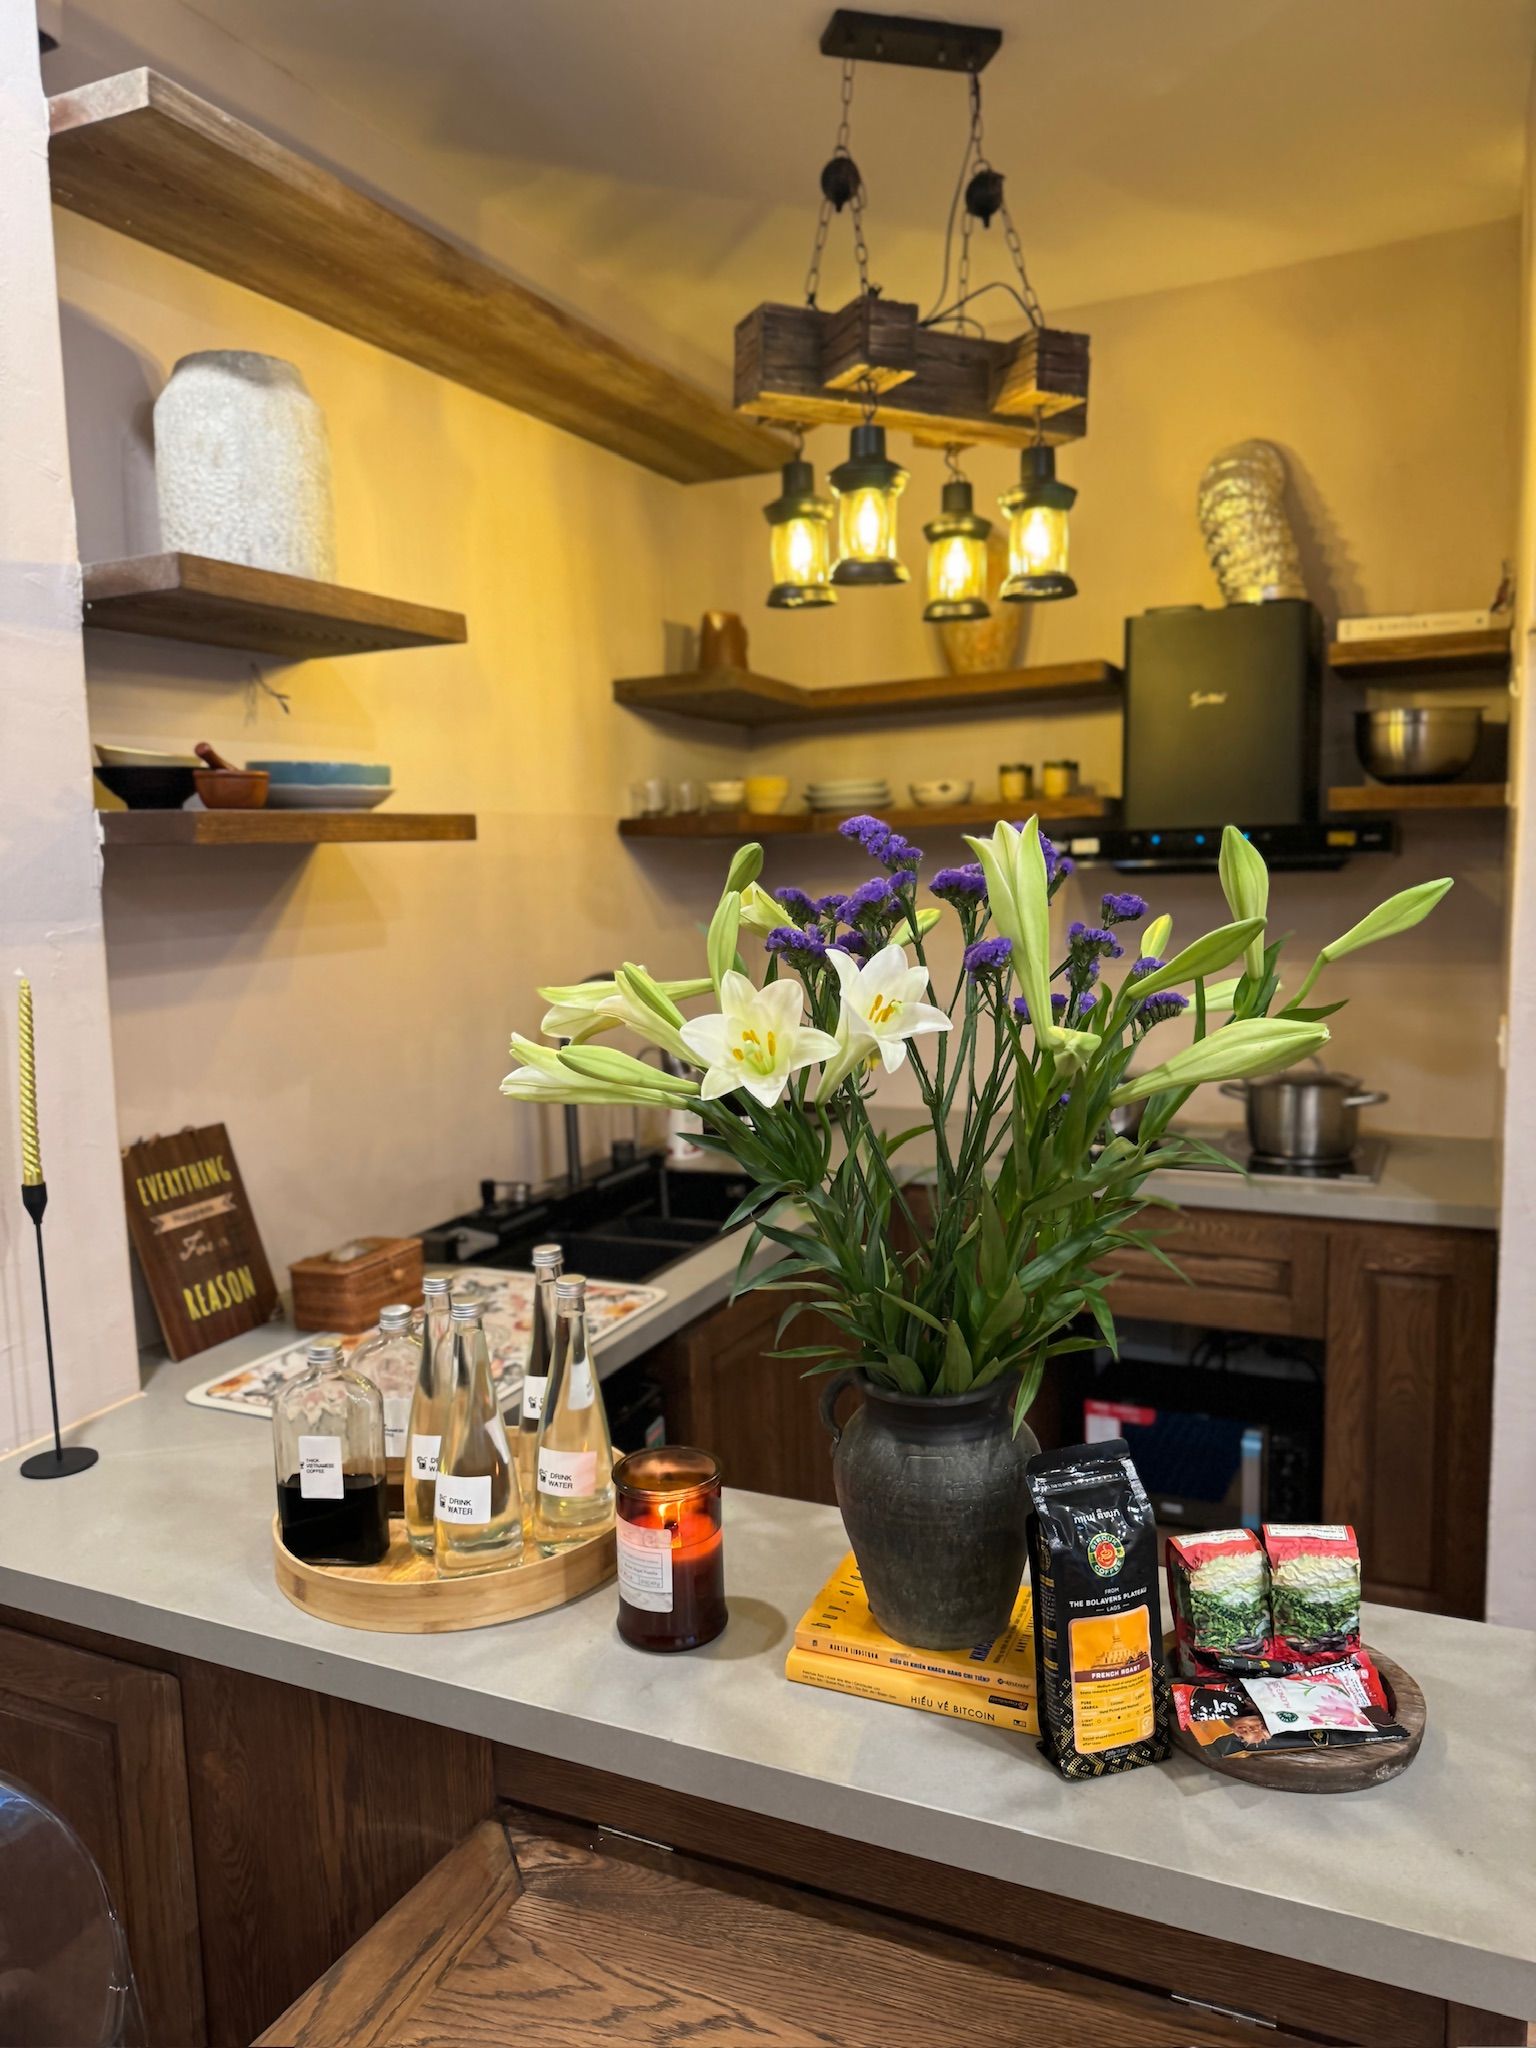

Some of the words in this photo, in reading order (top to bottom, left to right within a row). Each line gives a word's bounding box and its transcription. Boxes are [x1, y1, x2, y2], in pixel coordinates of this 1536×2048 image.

[136, 1155, 232, 1207] EVERYTHING
[182, 1265, 257, 1321] REASON
[549, 1472, 573, 1481] DRINK
[548, 1480, 573, 1489] WATER
[449, 1497, 472, 1506] DRINK
[447, 1506, 473, 1516] WATER
[1094, 1561, 1122, 1575] COFFEE
[1104, 1587, 1120, 1595] FROM
[1069, 1599, 1084, 1608] THE
[1085, 1594, 1122, 1607] BOLAYENS
[1123, 1587, 1148, 1600] PLATEAU
[1106, 1604, 1121, 1612] LAOS
[1091, 1671, 1120, 1679] FRENCH
[1120, 1664, 1141, 1675] ROAST
[953, 1706, 995, 1721] BITCOIN
